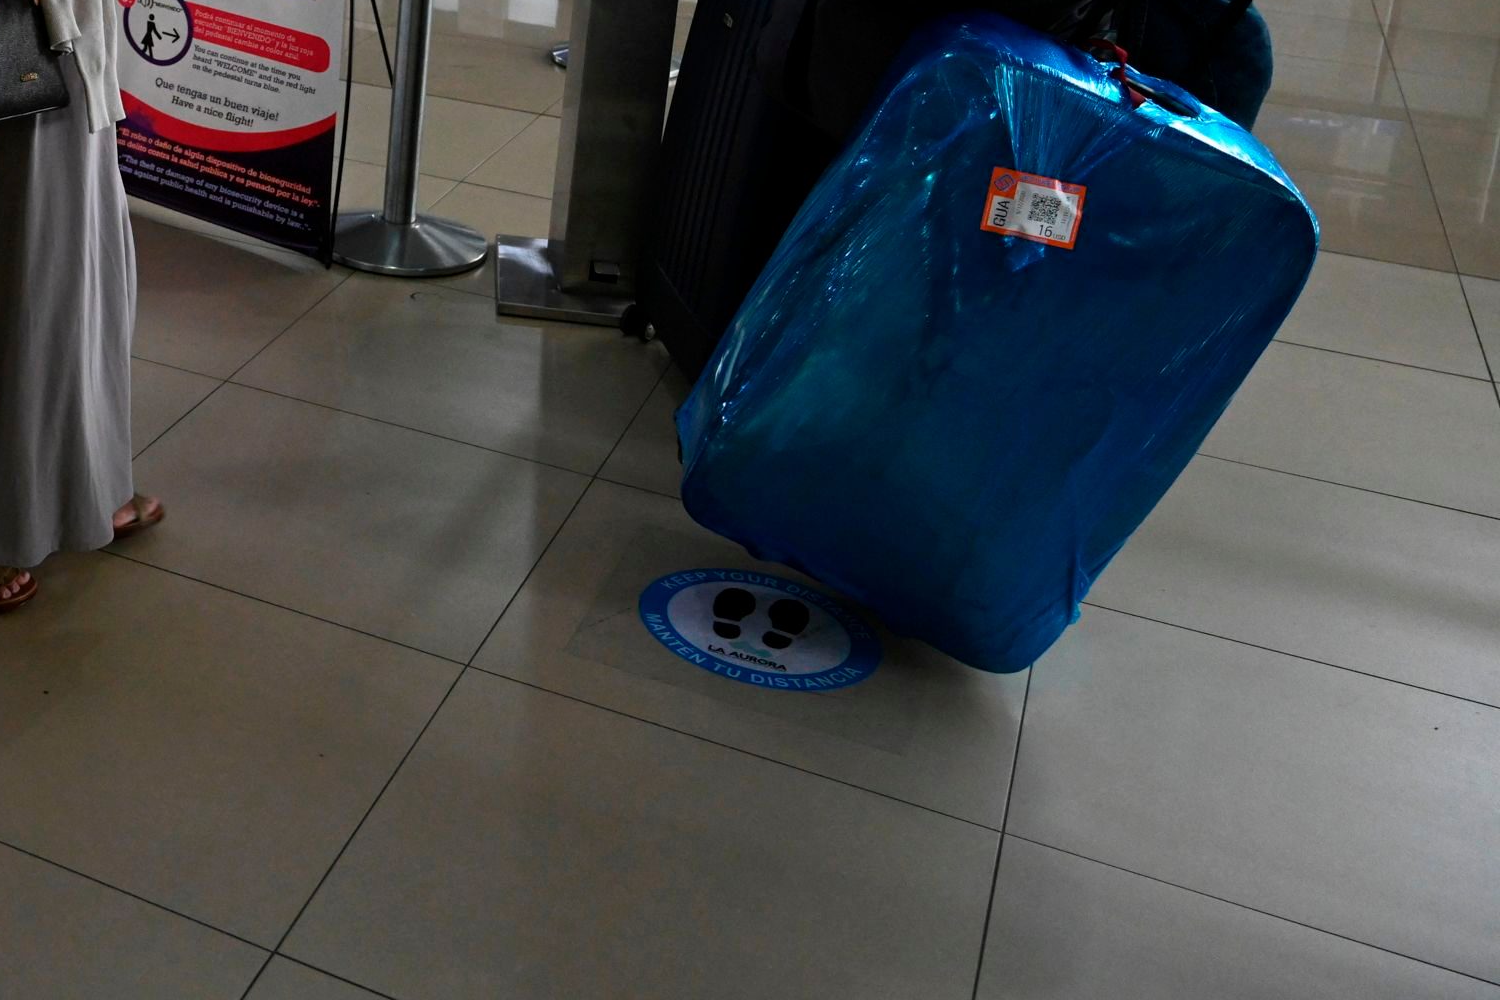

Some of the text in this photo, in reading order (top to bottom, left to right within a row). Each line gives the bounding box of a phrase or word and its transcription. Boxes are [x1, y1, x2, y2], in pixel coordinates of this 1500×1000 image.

[155, 77, 279, 121] Que tengas un buen viaje!
[172, 96, 194, 109] Have
[204, 107, 224, 118] nice
[226, 112, 254, 127] flight!
[993, 200, 1010, 227] GUA
[1039, 224, 1053, 238] 16
[660, 570, 871, 641] KEEP YOUR DISTANCE
[708, 644, 787, 671] LA AURORA
[711, 661, 741, 679] TU
[750, 664, 864, 690] DISTANCIA
